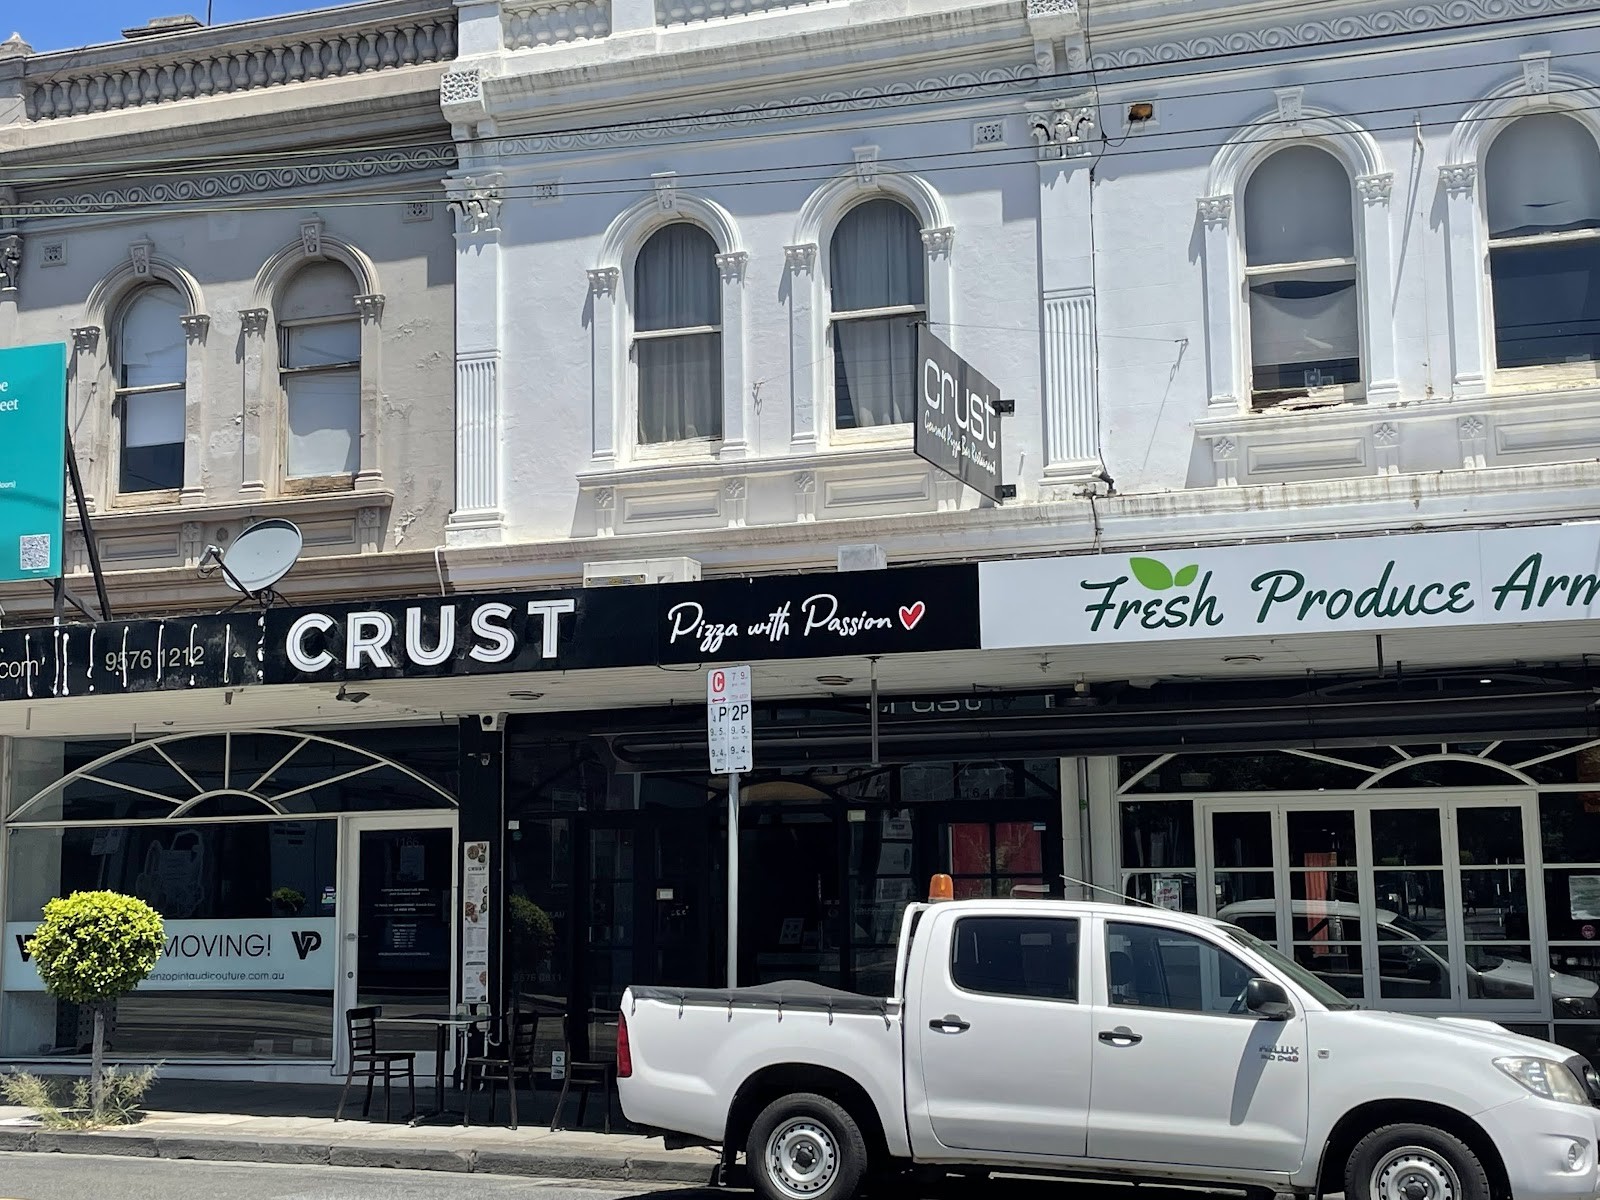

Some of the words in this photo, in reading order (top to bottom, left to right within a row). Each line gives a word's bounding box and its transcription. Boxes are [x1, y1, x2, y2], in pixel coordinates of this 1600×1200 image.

[924, 358, 996, 449] crust
[668, 602, 738, 653] Pizza
[748, 601, 791, 642] with
[801, 593, 892, 637] Passion
[1080, 571, 1224, 632] Fresh
[1251, 560, 1474, 623] Produce
[105, 650, 151, 672] 9576
[161, 646, 205, 668] 1212
[286, 598, 575, 672] CRUST
[732, 704, 749, 721] 2P
[164, 934, 271, 957] MOVING!
